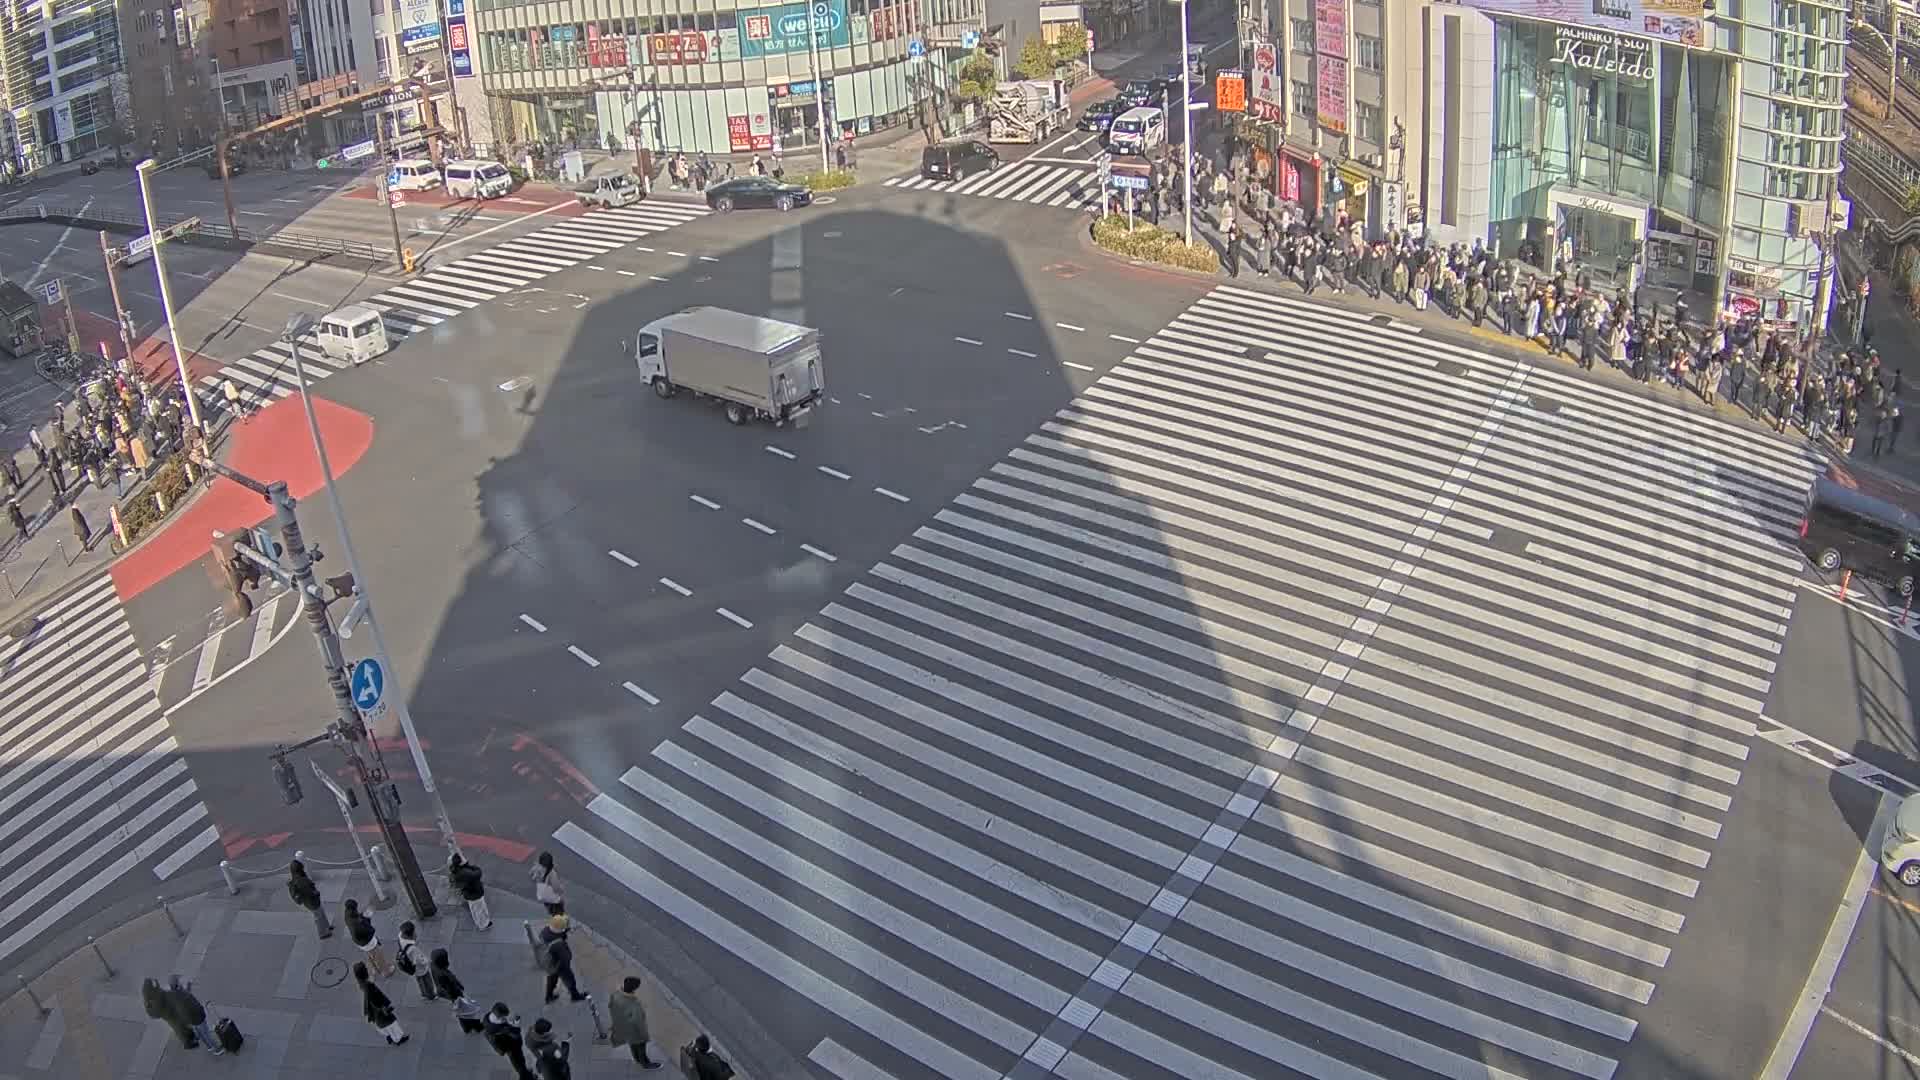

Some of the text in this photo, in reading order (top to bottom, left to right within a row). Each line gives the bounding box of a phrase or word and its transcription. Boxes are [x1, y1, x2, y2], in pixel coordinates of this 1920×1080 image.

[1555, 26, 1612, 44] PACHINKO
[1624, 39, 1650, 51] SLOT
[1550, 38, 1655, 80] Kaleido
[730, 124, 749, 134] FREE
[731, 117, 747, 125] TAX
